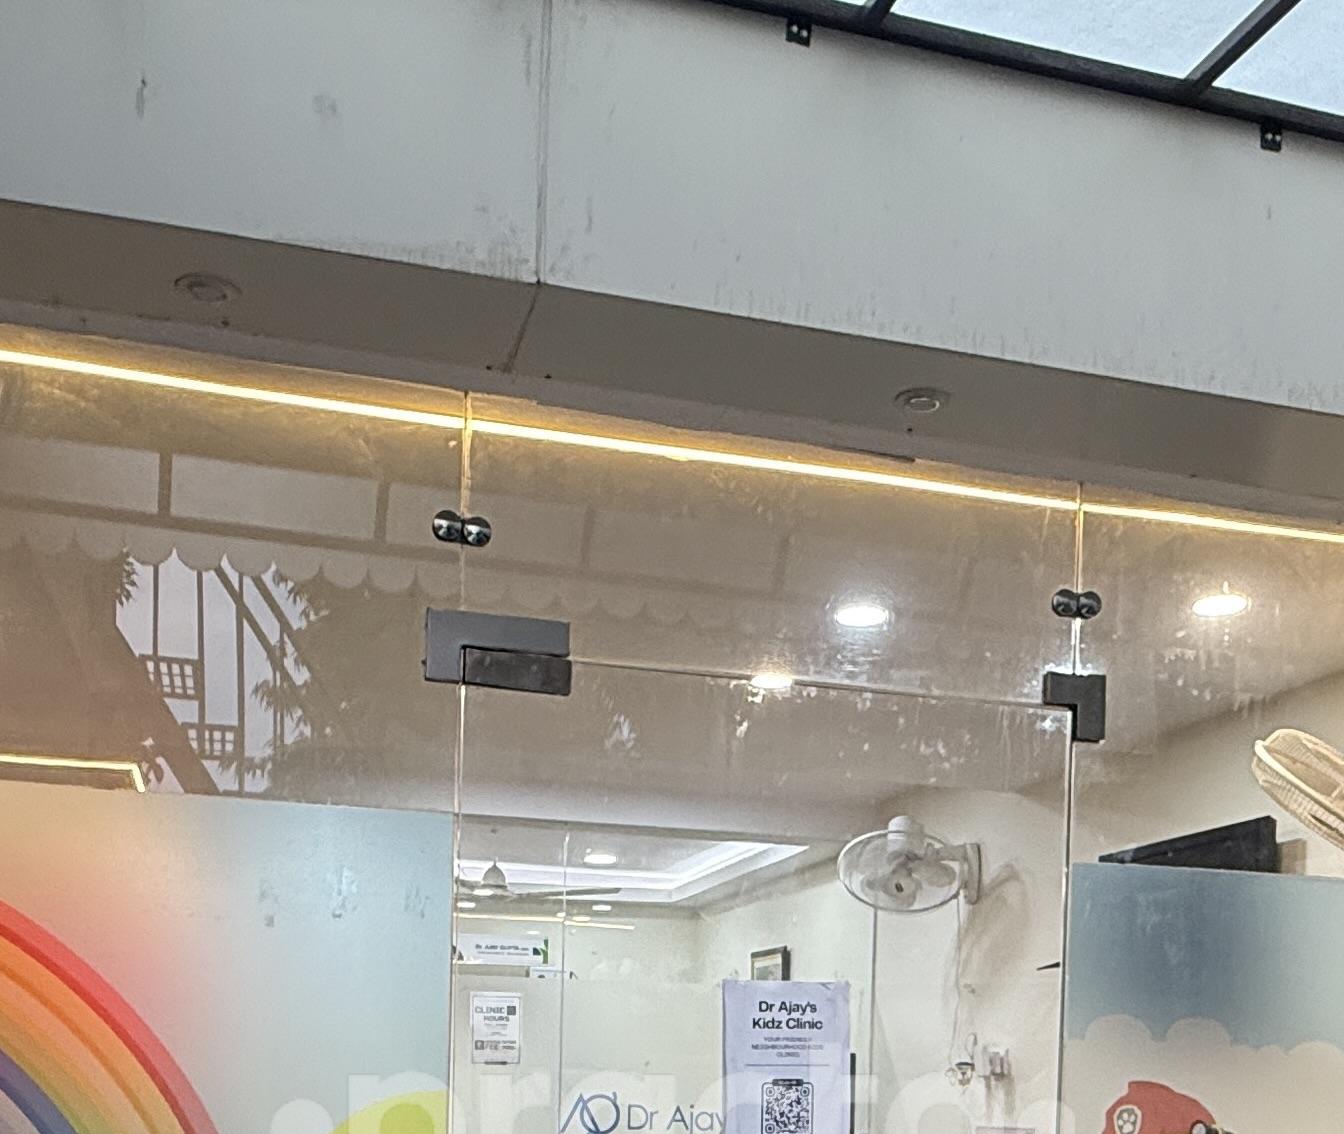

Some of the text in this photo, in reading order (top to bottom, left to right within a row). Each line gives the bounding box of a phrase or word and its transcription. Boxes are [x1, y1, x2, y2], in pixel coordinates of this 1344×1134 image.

[475, 1006, 505, 1014] CLINIC
[759, 1001, 817, 1016] Dr Ajay's
[752, 1017, 823, 1030] Kidz Clinic
[628, 1104, 659, 1131] Dr
